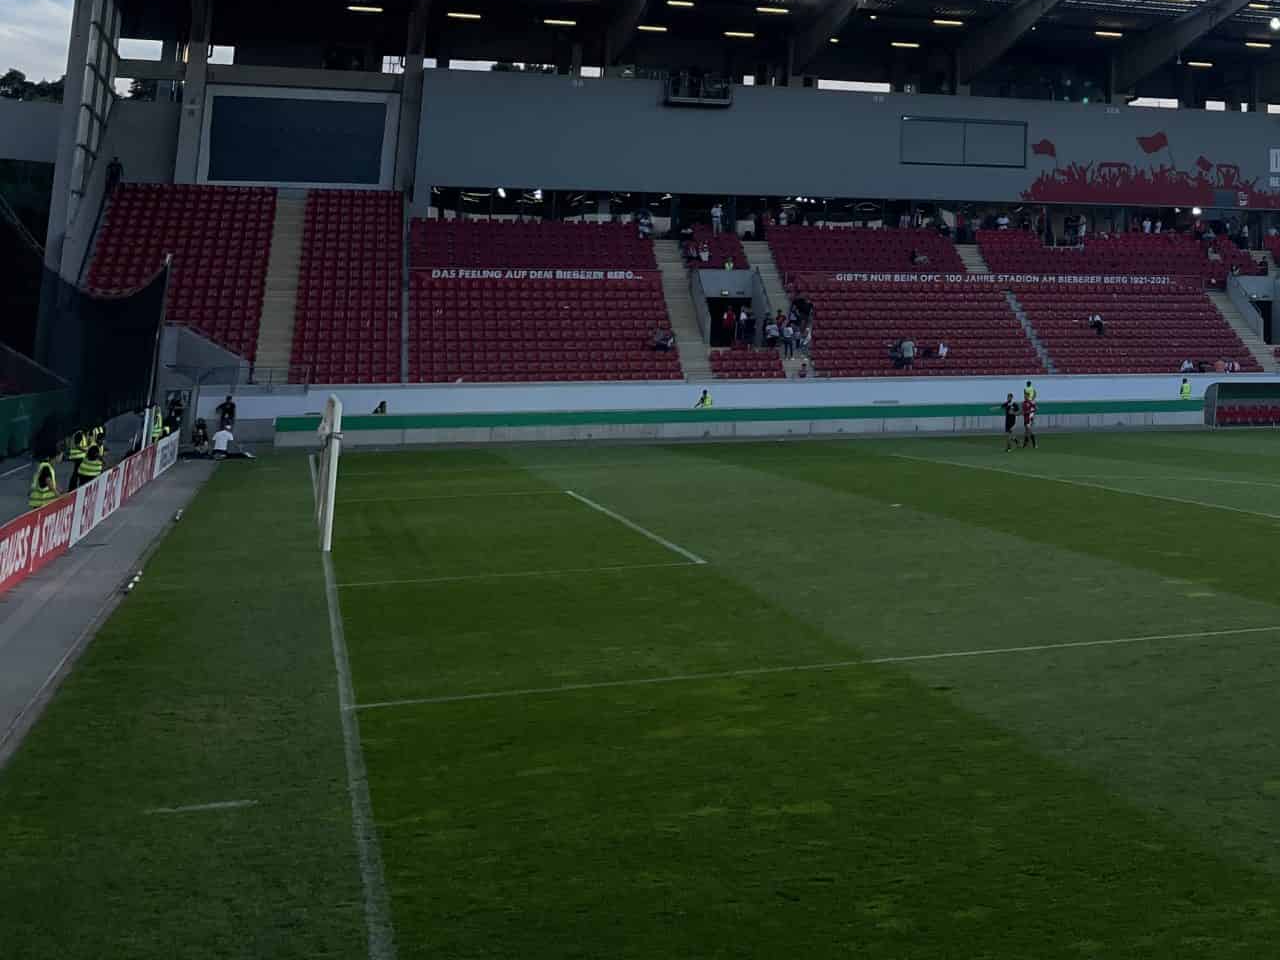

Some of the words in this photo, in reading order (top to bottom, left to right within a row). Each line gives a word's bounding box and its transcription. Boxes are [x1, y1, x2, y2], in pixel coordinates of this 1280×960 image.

[431, 269, 457, 279] DAS
[458, 269, 502, 279] FEELING
[505, 269, 528, 279] AUF
[529, 269, 553, 279] DEM
[870, 273, 890, 282] NUR
[894, 273, 918, 282] BEIM
[919, 273, 941, 283] OFC
[945, 274, 962, 283] 100
[964, 274, 994, 283] JAHRE
[998, 274, 1040, 283] STADION
[1057, 275, 1102, 284] BIEBERER
[1103, 276, 1128, 285] BERG
